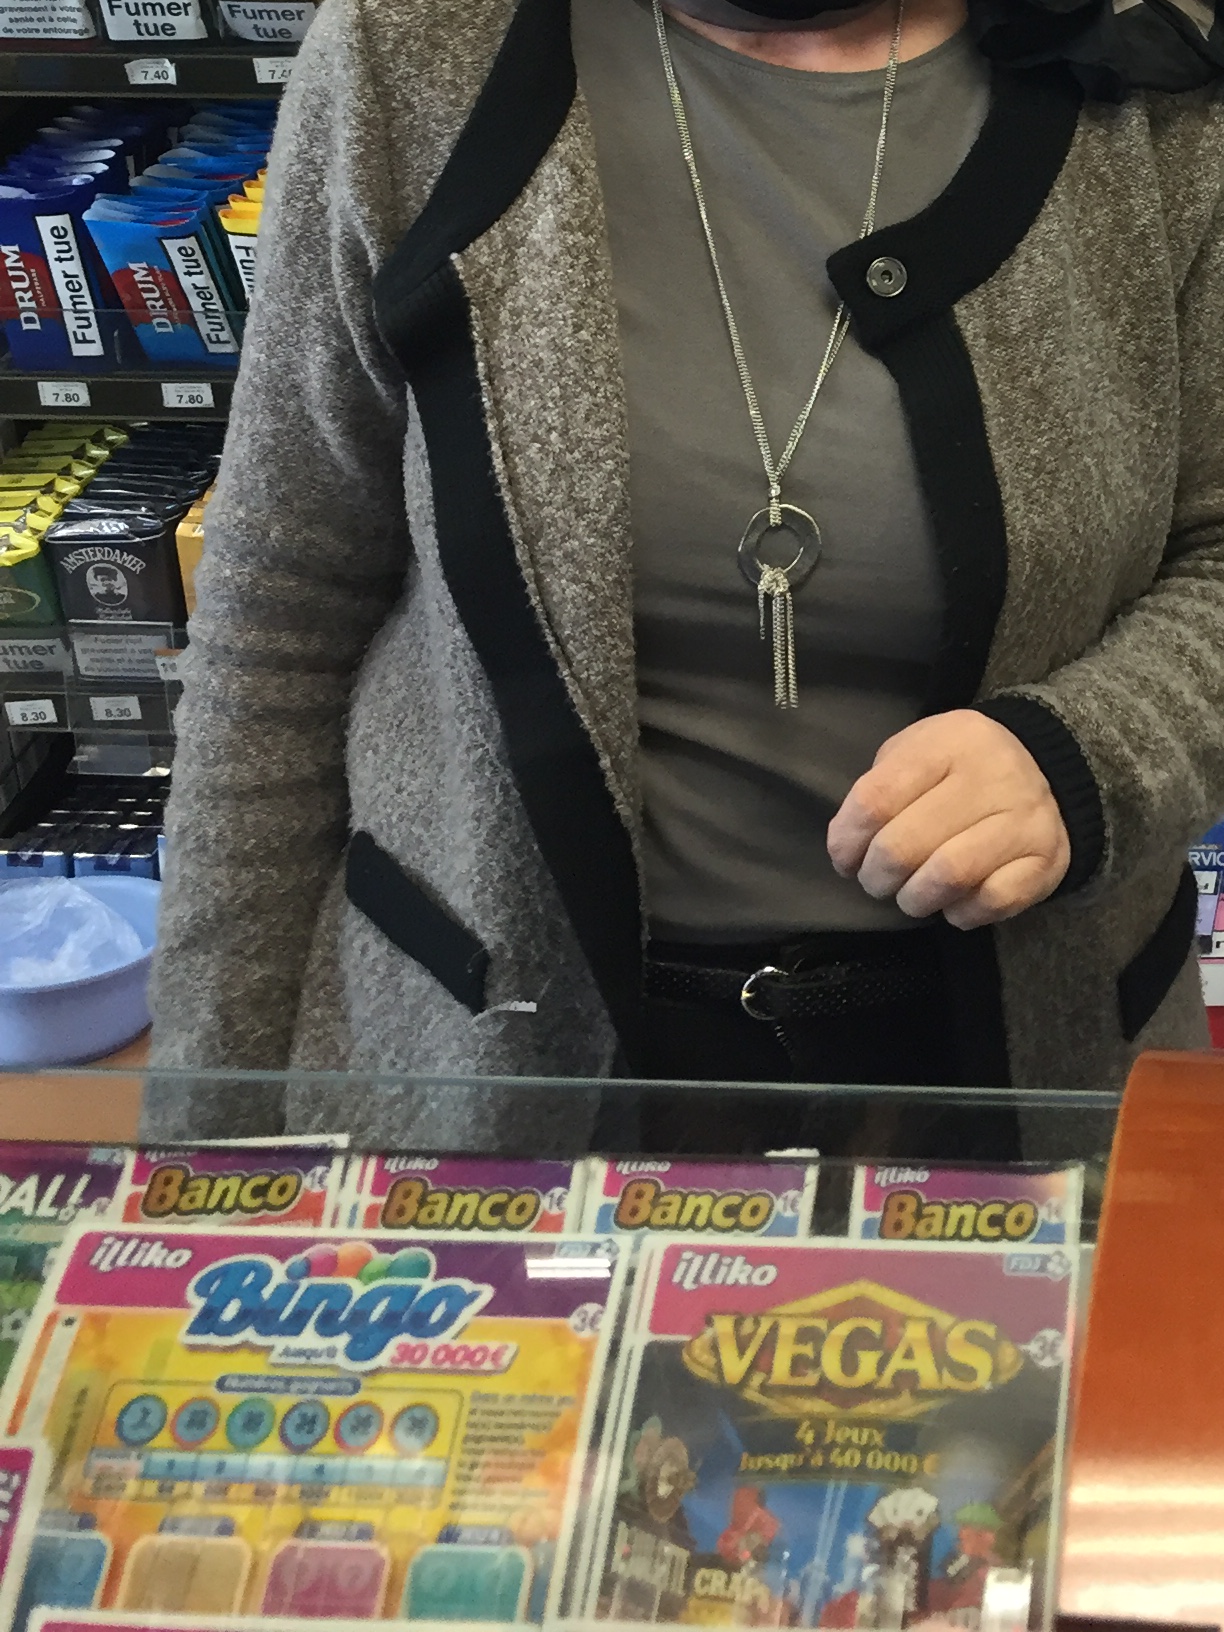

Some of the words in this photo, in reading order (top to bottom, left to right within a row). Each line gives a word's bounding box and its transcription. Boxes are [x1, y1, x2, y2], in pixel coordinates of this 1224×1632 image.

[133, 19, 177, 38] tue
[50, 224, 74, 264] tue
[1, 244, 42, 331] DRUM
[60, 269, 97, 345] Fumer
[52, 391, 80, 404] 7.80
[60, 545, 147, 575] AMSTERDAMER
[105, 706, 132, 719] 8.30
[143, 1166, 302, 1218] Banco
[614, 1180, 773, 1231] Banco
[880, 1192, 1038, 1239] Banco
[90, 1234, 192, 1271] illiko
[187, 1258, 486, 1362] Bingo
[711, 1314, 998, 1392] VEGAS
